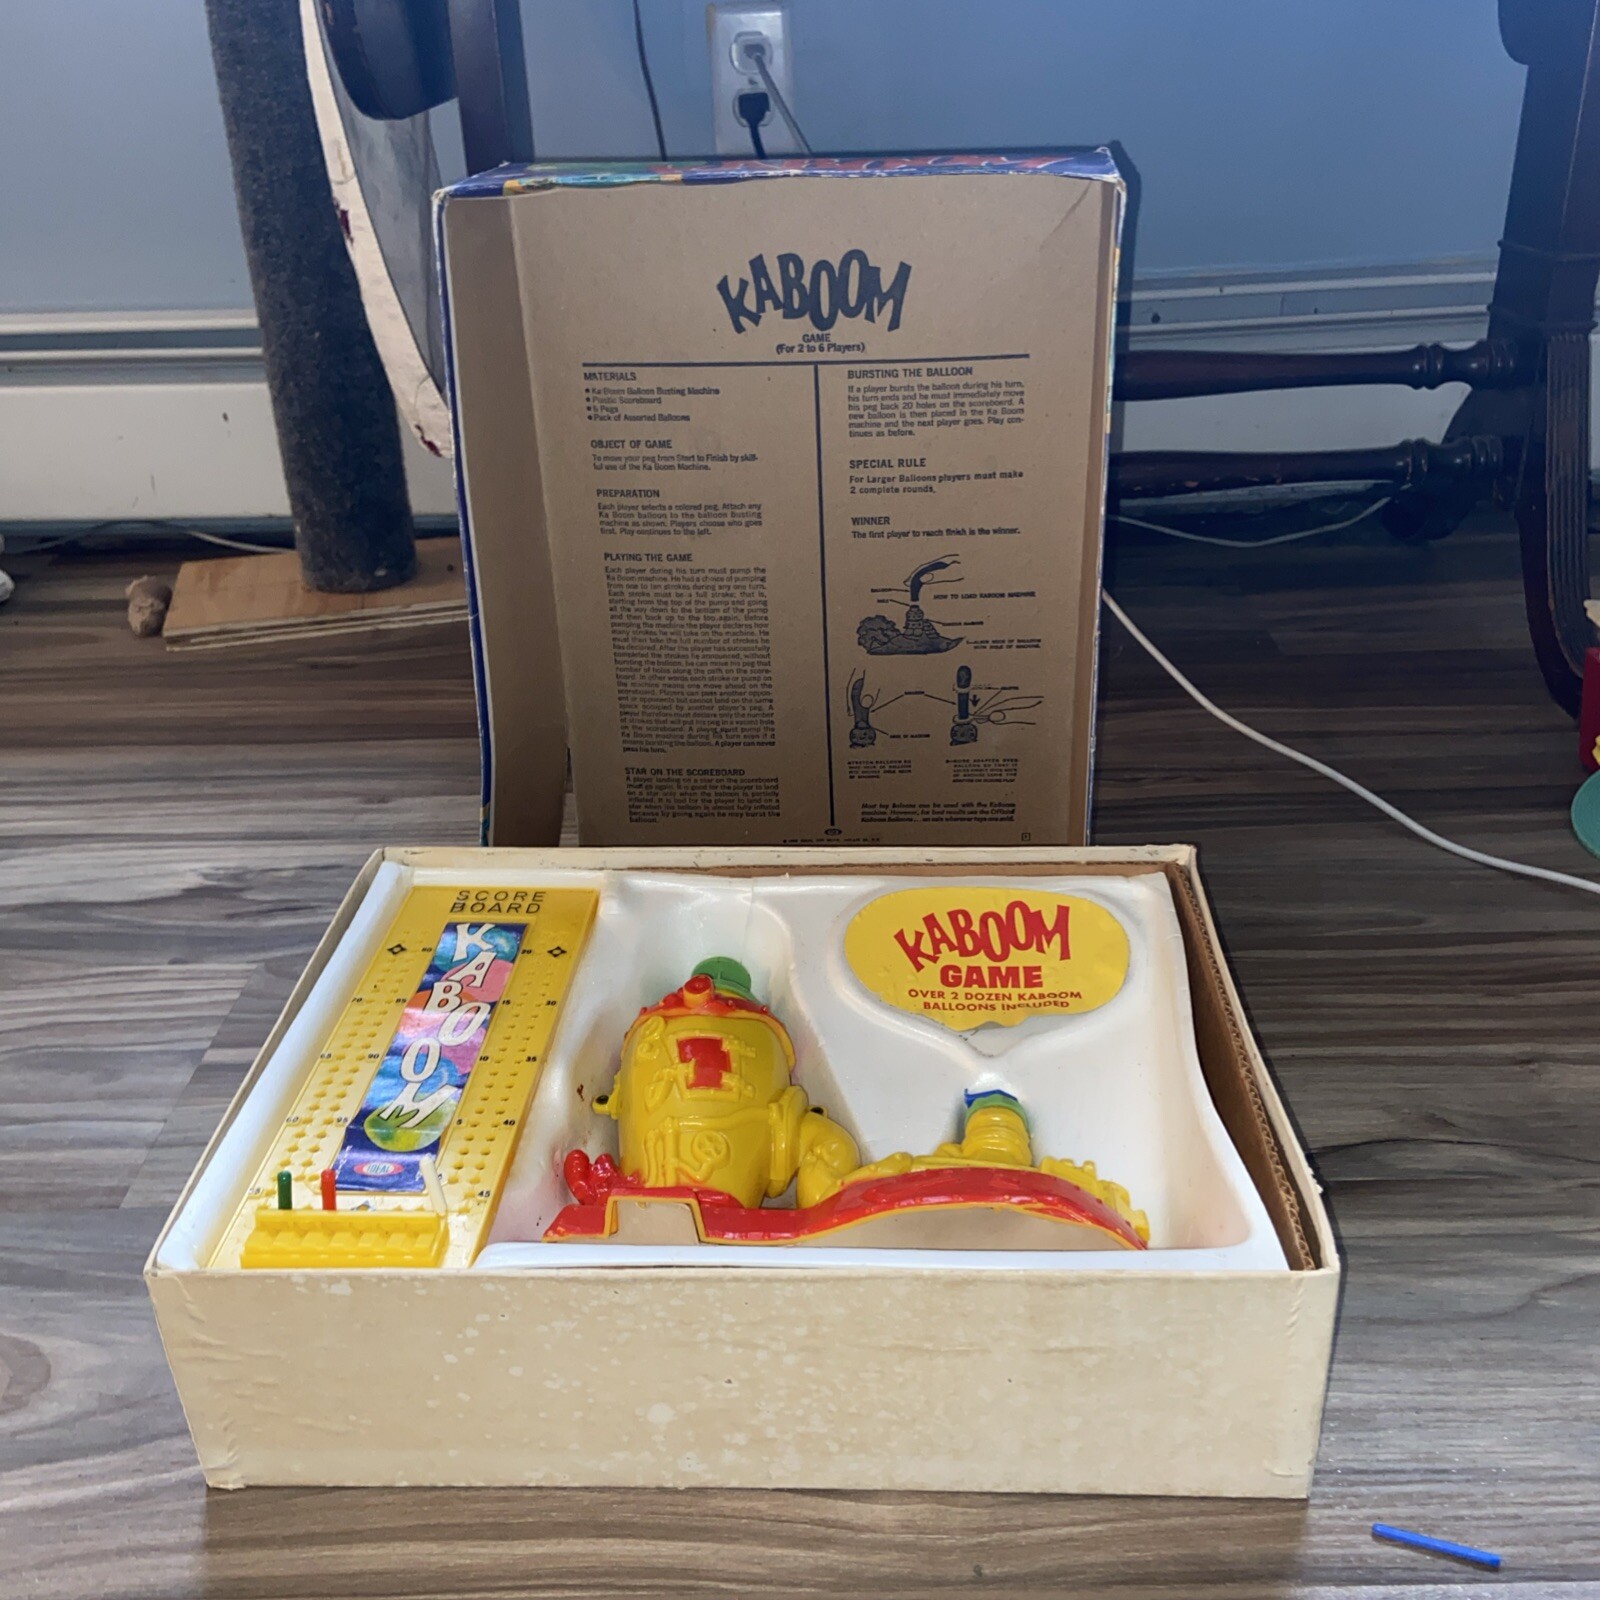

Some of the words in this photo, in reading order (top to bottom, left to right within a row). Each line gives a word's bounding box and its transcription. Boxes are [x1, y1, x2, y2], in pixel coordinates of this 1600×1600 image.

[716, 249, 912, 334] KABOOM
[802, 333, 830, 343] GAME
[797, 344, 804, 353] 2
[806, 344, 816, 352] to
[818, 344, 825, 352] 6
[827, 343, 865, 353] Players)
[583, 372, 637, 381] MATERIALS
[847, 369, 899, 379] BURSTING
[902, 368, 922, 377] THE
[926, 367, 973, 377] BALLOON
[863, 385, 887, 394] player
[889, 384, 915, 392] bursts
[931, 383, 960, 391] balloon
[962, 382, 989, 391] during
[862, 394, 879, 402] turn
[902, 393, 917, 401] and
[931, 392, 950, 400] must
[863, 404, 877, 412] peg
[880, 402, 899, 410] back
[916, 401, 936, 409] holes
[952, 400, 965, 408] the
[1018, 398, 1024, 406] A
[867, 411, 896, 419] balloon
[899, 411, 906, 419] is
[909, 410, 927, 418] then
[931, 409, 956, 419] placed
[959, 409, 967, 417] in
[970, 408, 983, 417] the
[987, 408, 998, 416] Ka
[1000, 407, 1024, 416] Boom
[848, 420, 881, 429] machine
[884, 420, 899, 428] and
[902, 419, 915, 428] the
[917, 419, 934, 427] next
[936, 418, 961, 428] player
[987, 417, 1004, 426] Play
[590, 440, 626, 449] OBJECT
[629, 440, 642, 449] OF
[645, 440, 672, 449] GAME
[592, 454, 601, 462] To
[624, 455, 640, 463] your
[642, 455, 656, 463] peg
[657, 454, 675, 462] from
[676, 453, 695, 462] Start
[696, 453, 704, 462] to
[705, 453, 728, 462] Finish
[729, 453, 739, 463] by
[849, 459, 894, 469] SPECIAL
[897, 458, 926, 468] RULE
[619, 463, 627, 471] of
[628, 463, 640, 471] the
[642, 463, 652, 471] Ka
[654, 463, 675, 471] Boom
[849, 475, 864, 483] For
[866, 474, 895, 484] Larger
[898, 472, 936, 482] Balloons
[938, 471, 971, 482] players
[974, 471, 997, 479] must
[999, 470, 1023, 479] make
[596, 489, 660, 498] PREPARATION
[850, 486, 856, 494] 2
[859, 485, 900, 495] complete
[598, 503, 614, 511] Each
[616, 503, 639, 512] player
[641, 503, 667, 511] selects
[675, 503, 702, 511] colored
[722, 503, 746, 511] Attach
[747, 504, 761, 512] any
[851, 516, 890, 526] WINNER
[852, 531, 867, 539] The
[868, 530, 885, 539] first
[886, 530, 910, 539] player
[912, 529, 920, 537] to
[922, 529, 944, 537] reach
[945, 528, 967, 536] finish
[968, 528, 976, 536] is
[992, 527, 1020, 535] winner.
[604, 553, 642, 561] PLAYING
[645, 553, 663, 562] THE
[666, 553, 693, 562] GAME
[686, 768, 745, 776] SCOREBOARD
[456, 890, 547, 902] SCORE
[450, 902, 541, 914] BOARD
[893, 900, 1071, 973] KABOOM
[940, 965, 1043, 989] GAME
[908, 989, 945, 1000] OVER
[951, 991, 958, 1000] 2
[965, 991, 1012, 1001] DOZEN
[1017, 991, 1082, 1001] KABOOM
[923, 1001, 997, 1012] BALLOONS
[1001, 1000, 1070, 1011] INCLUDED
[379, 923, 497, 1128] KABOOM
[366, 1163, 392, 1174] IDEAL
